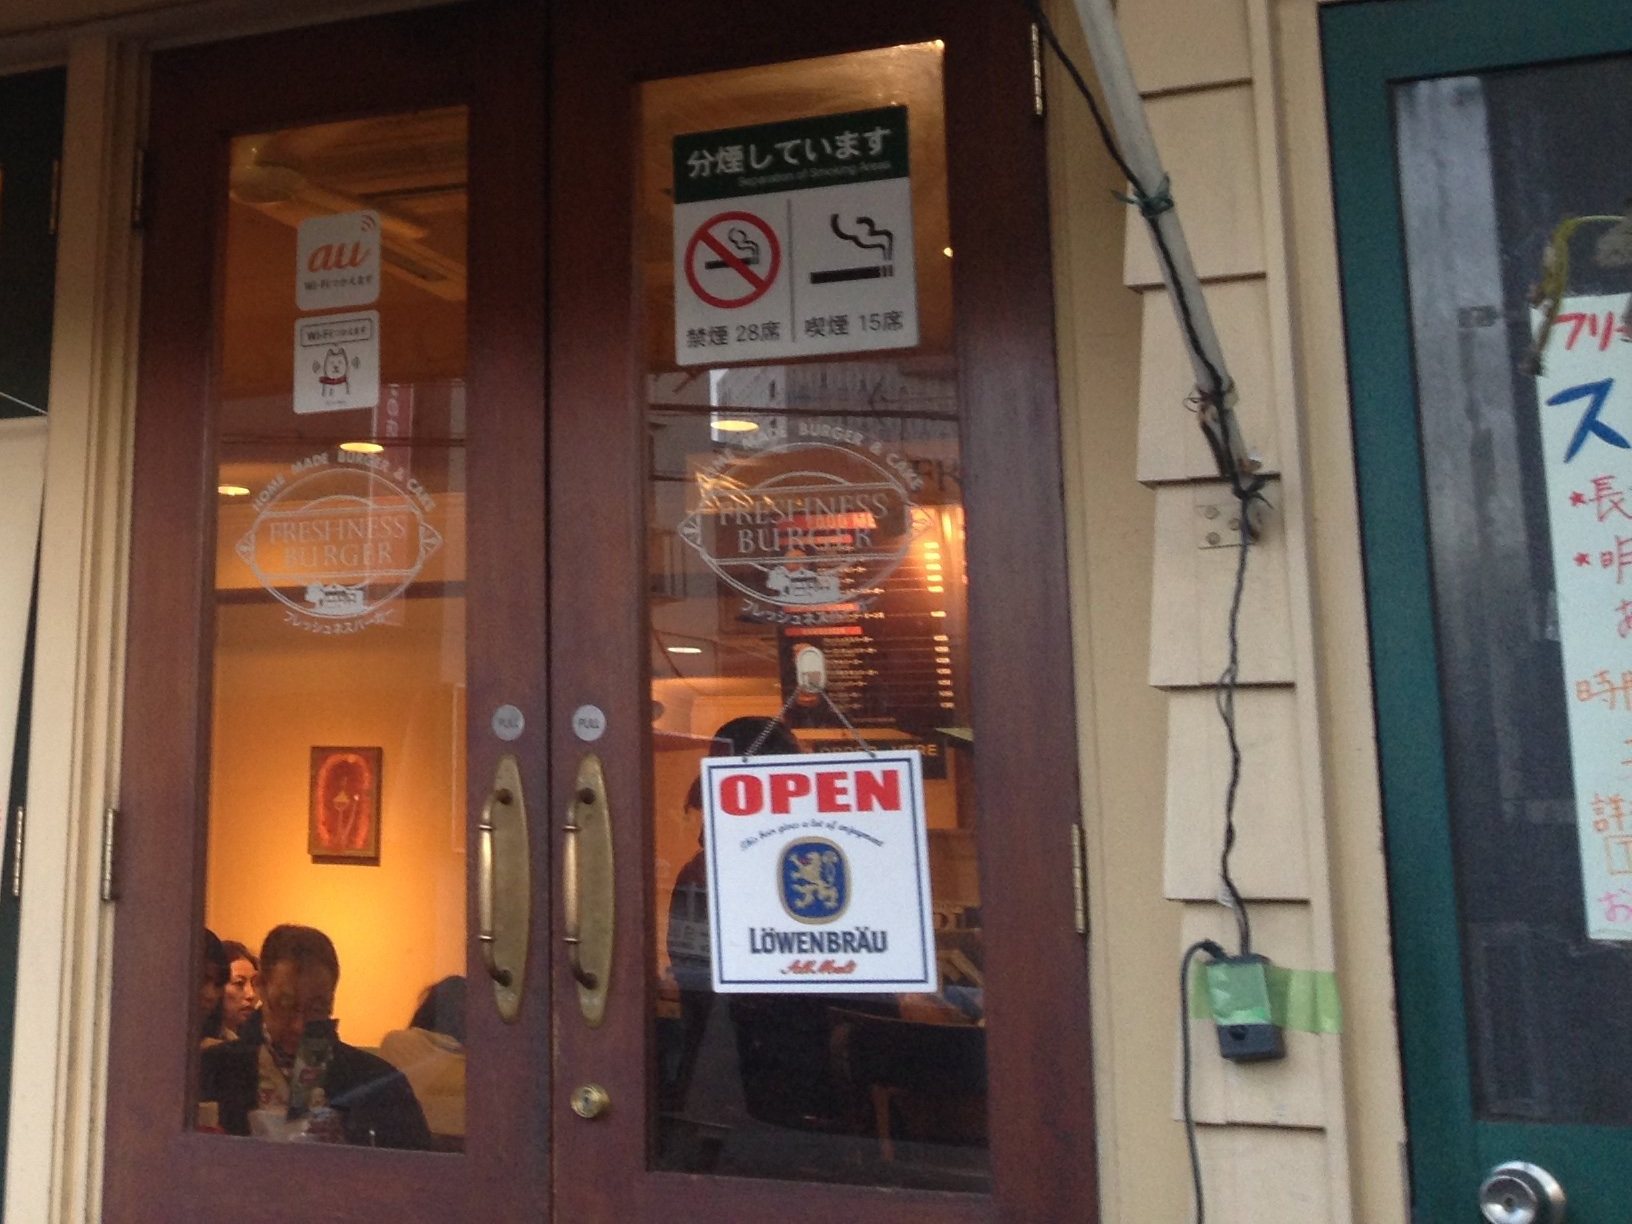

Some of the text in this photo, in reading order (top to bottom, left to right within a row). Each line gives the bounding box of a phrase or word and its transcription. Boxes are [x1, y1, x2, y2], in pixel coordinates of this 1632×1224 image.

[687, 126, 891, 178] 分煙しています
[307, 241, 372, 273] au
[686, 327, 729, 348] 禁煙
[804, 314, 849, 338] 喫煙
[1546, 377, 1632, 464] ス
[718, 493, 891, 526] FRESHNESS
[268, 515, 408, 544] FRESHNESS
[737, 526, 873, 554] BURGER
[283, 541, 393, 569] BURGER
[719, 769, 902, 817] OPEN
[749, 927, 888, 955] LÖWENBRÄU
